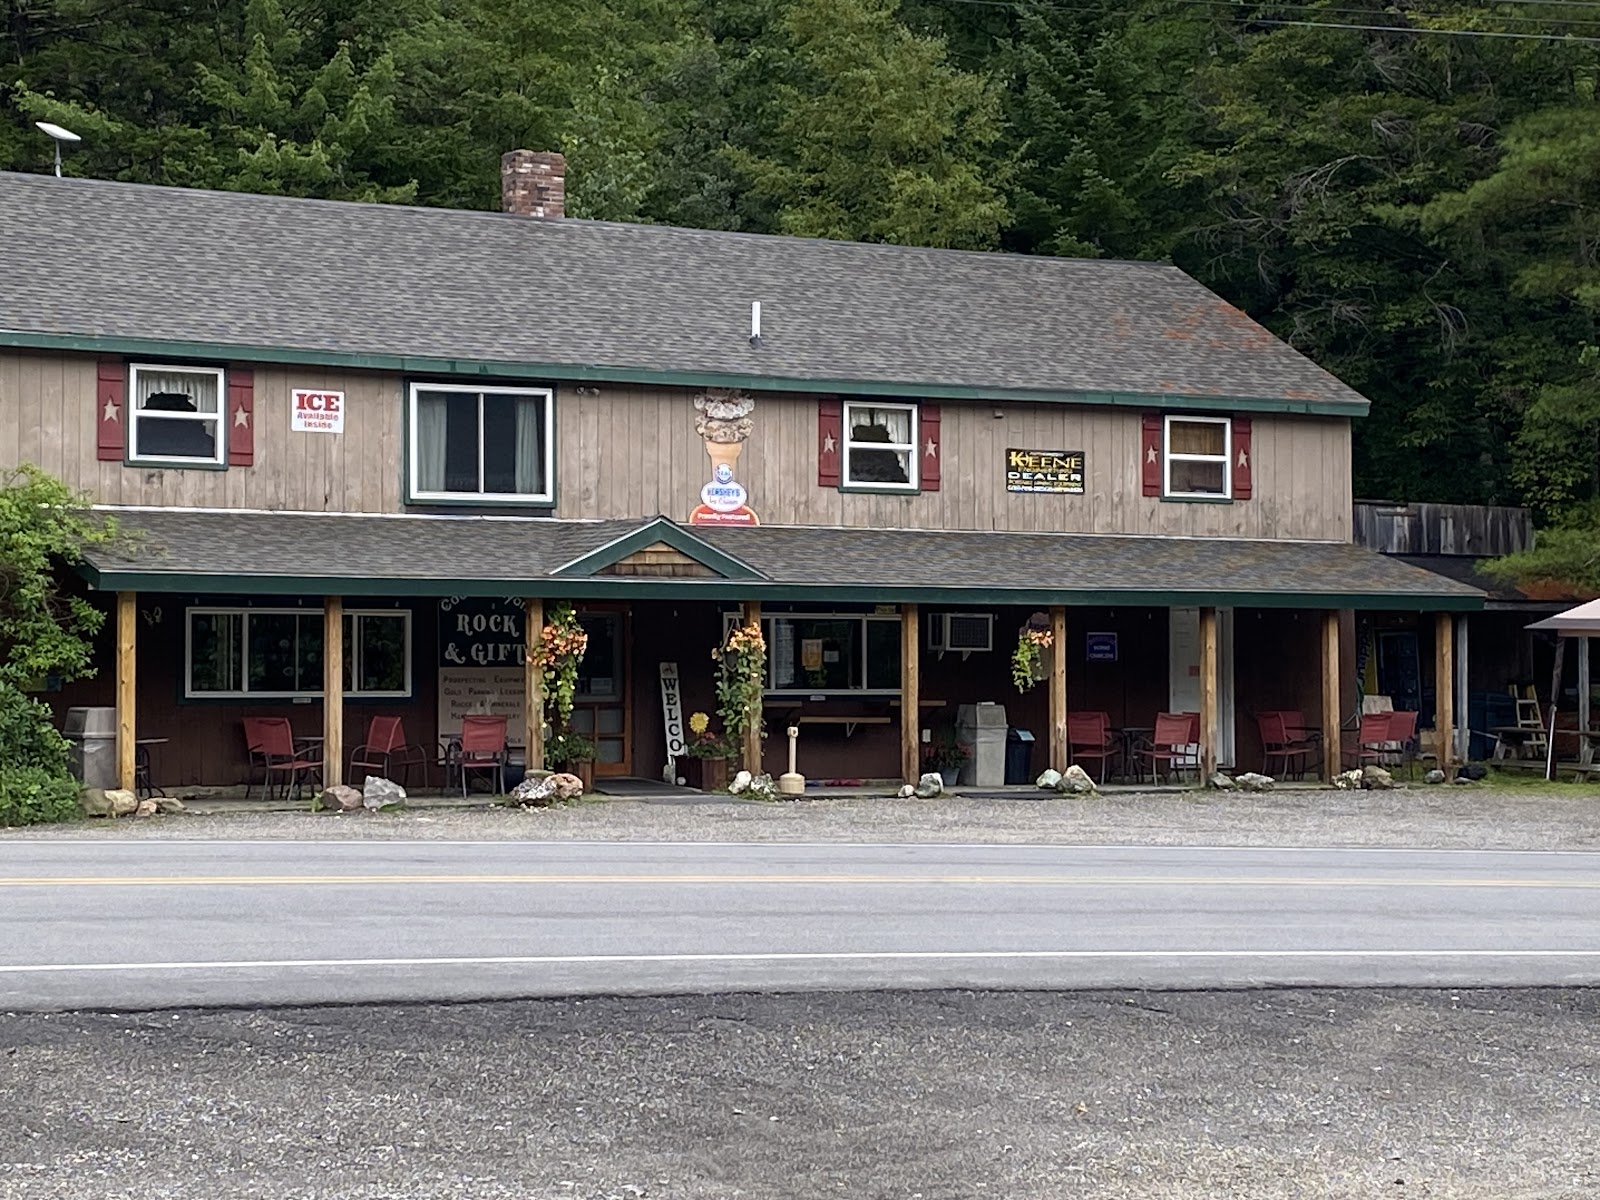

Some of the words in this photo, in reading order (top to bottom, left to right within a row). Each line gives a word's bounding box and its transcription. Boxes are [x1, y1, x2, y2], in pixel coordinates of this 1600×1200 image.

[296, 393, 340, 412] ICE
[297, 411, 339, 422] Available
[304, 420, 332, 429] Inside
[1009, 451, 1082, 469] KEENE
[1007, 471, 1081, 481] DEALER
[456, 613, 520, 638] ROCK
[444, 642, 467, 665] &
[661, 678, 682, 753] WELCO
